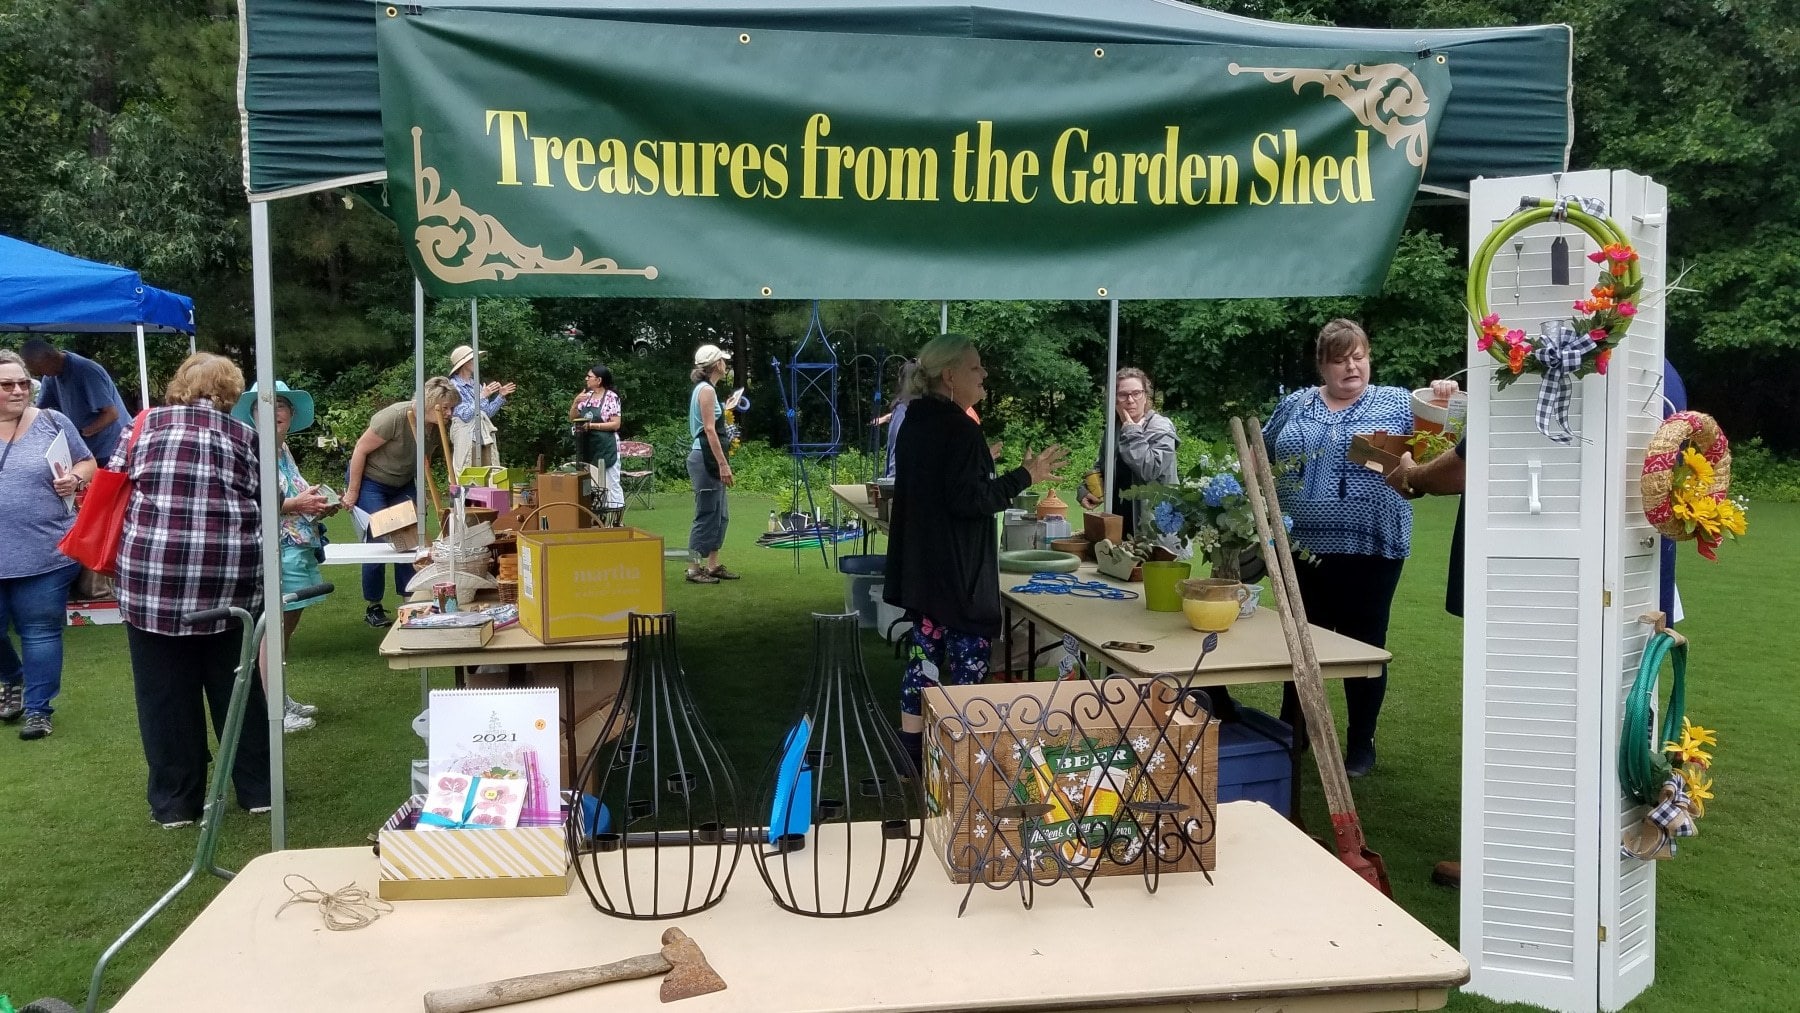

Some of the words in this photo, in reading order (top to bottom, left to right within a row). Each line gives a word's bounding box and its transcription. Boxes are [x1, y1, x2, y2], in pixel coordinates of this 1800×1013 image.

[485, 109, 789, 200] Treasures
[799, 113, 939, 201] from
[952, 120, 1040, 203] the
[1051, 125, 1239, 205] Garden
[1249, 128, 1376, 205] Shed
[472, 733, 517, 743] 2021
[1055, 749, 1128, 769] BEER
